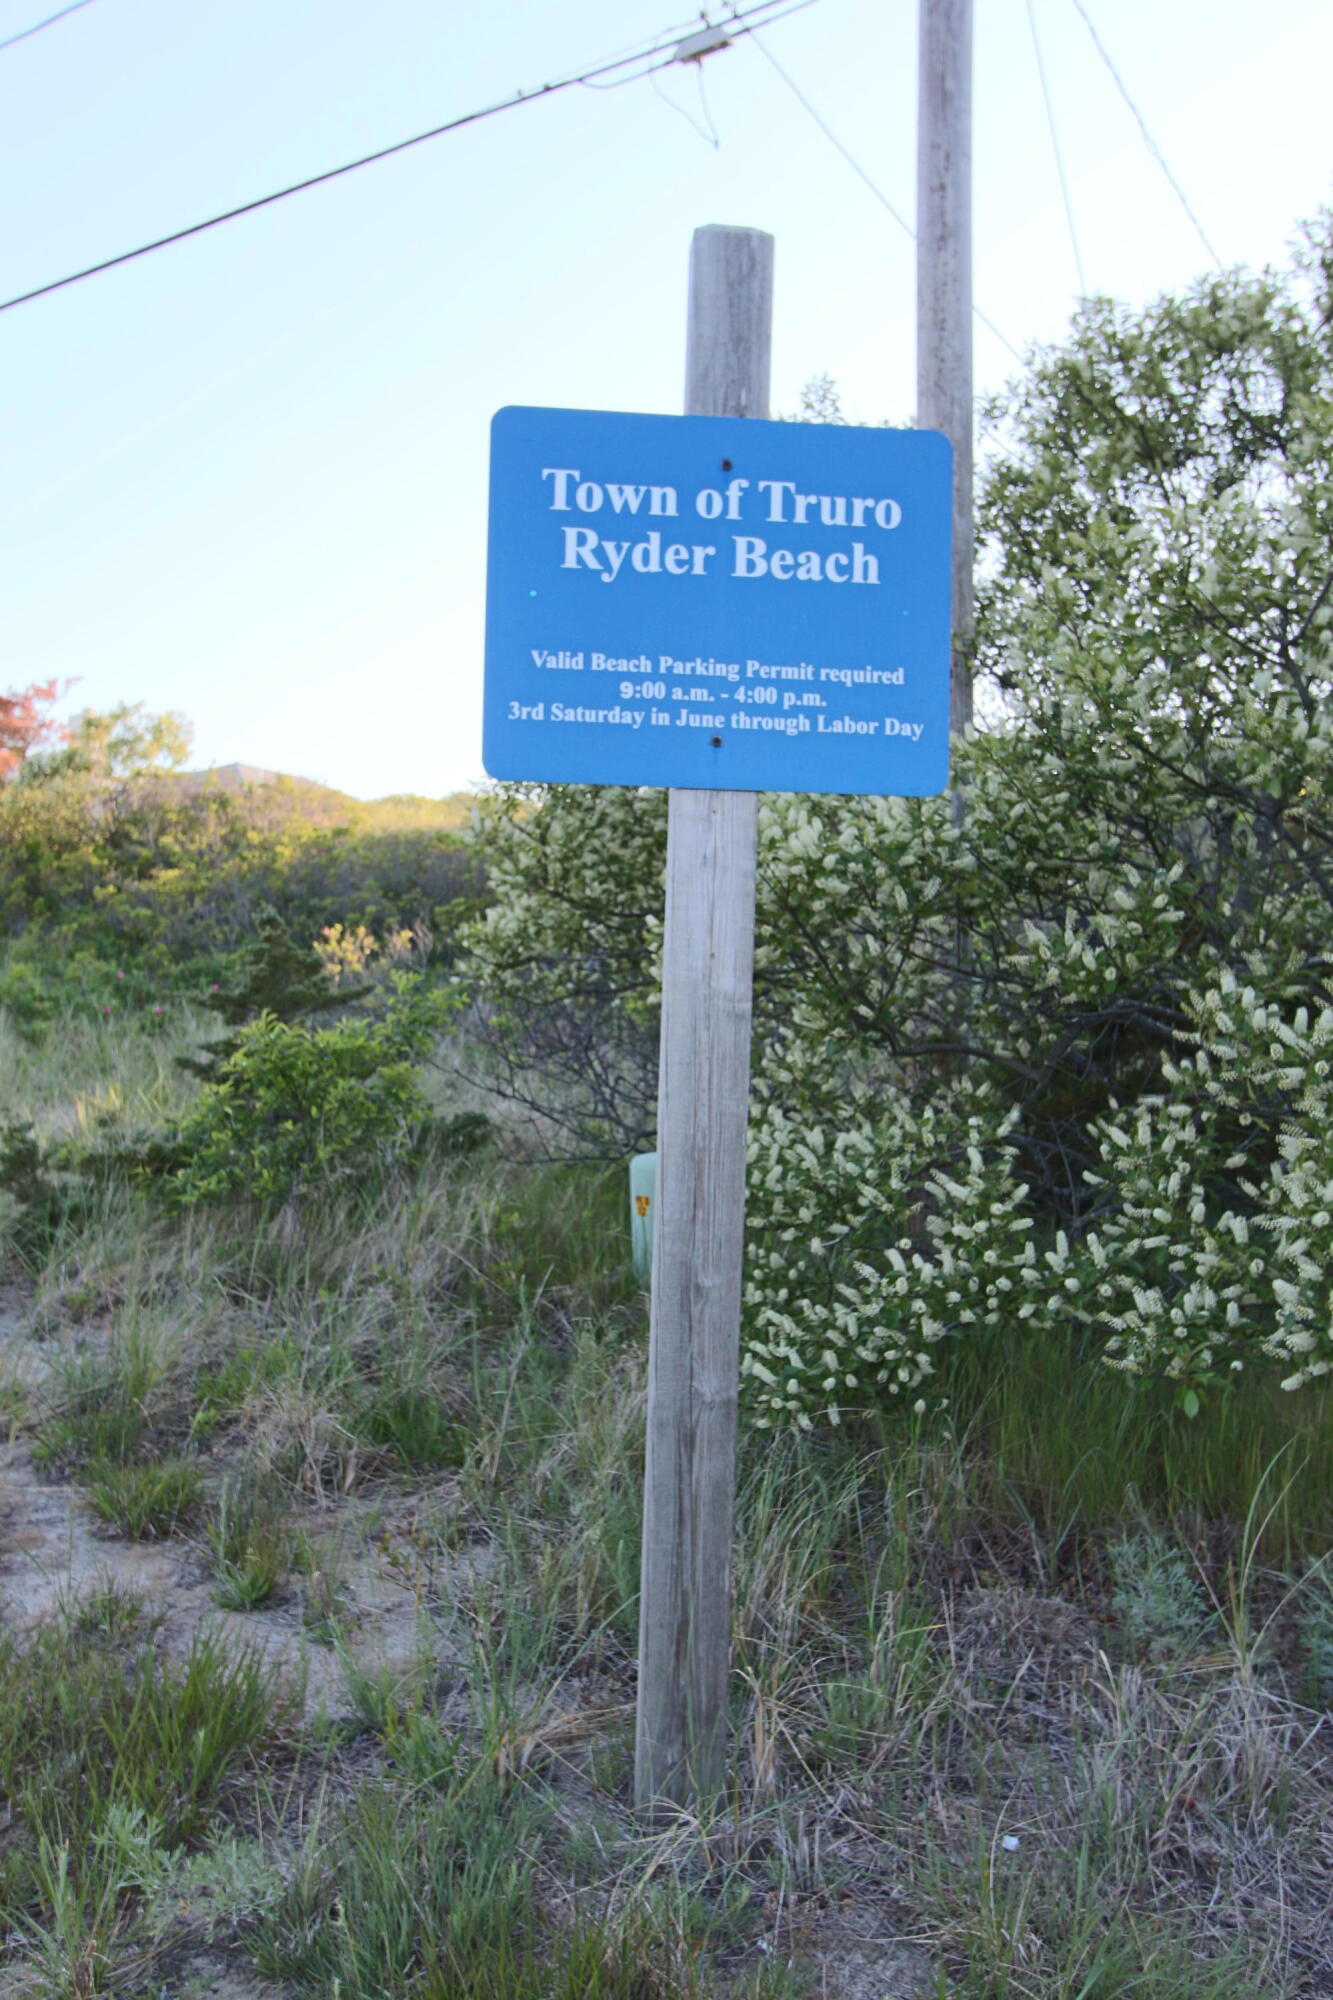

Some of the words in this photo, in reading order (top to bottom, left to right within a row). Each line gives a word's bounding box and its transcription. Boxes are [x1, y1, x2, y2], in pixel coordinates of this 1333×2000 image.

[542, 468, 678, 516] Town
[696, 479, 749, 520] of
[759, 481, 901, 528] Truro
[561, 527, 715, 582] Ryder
[732, 536, 880, 584] Beach
[532, 650, 584, 669] Valid
[592, 653, 651, 672] Beach
[660, 656, 739, 681] Parking
[747, 660, 814, 680] Permit
[821, 666, 904, 687] required
[620, 681, 666, 699] 9:00
[672, 688, 714, 701] a.m.
[735, 686, 777, 704] 4:00
[784, 692, 826, 709] p.m.
[508, 701, 544, 720] 3rd
[551, 703, 644, 728] Saturday
[651, 707, 670, 725] in
[676, 709, 725, 728] June
[731, 712, 810, 736] through
[818, 715, 879, 734] Labor
[885, 718, 923, 741] Day
